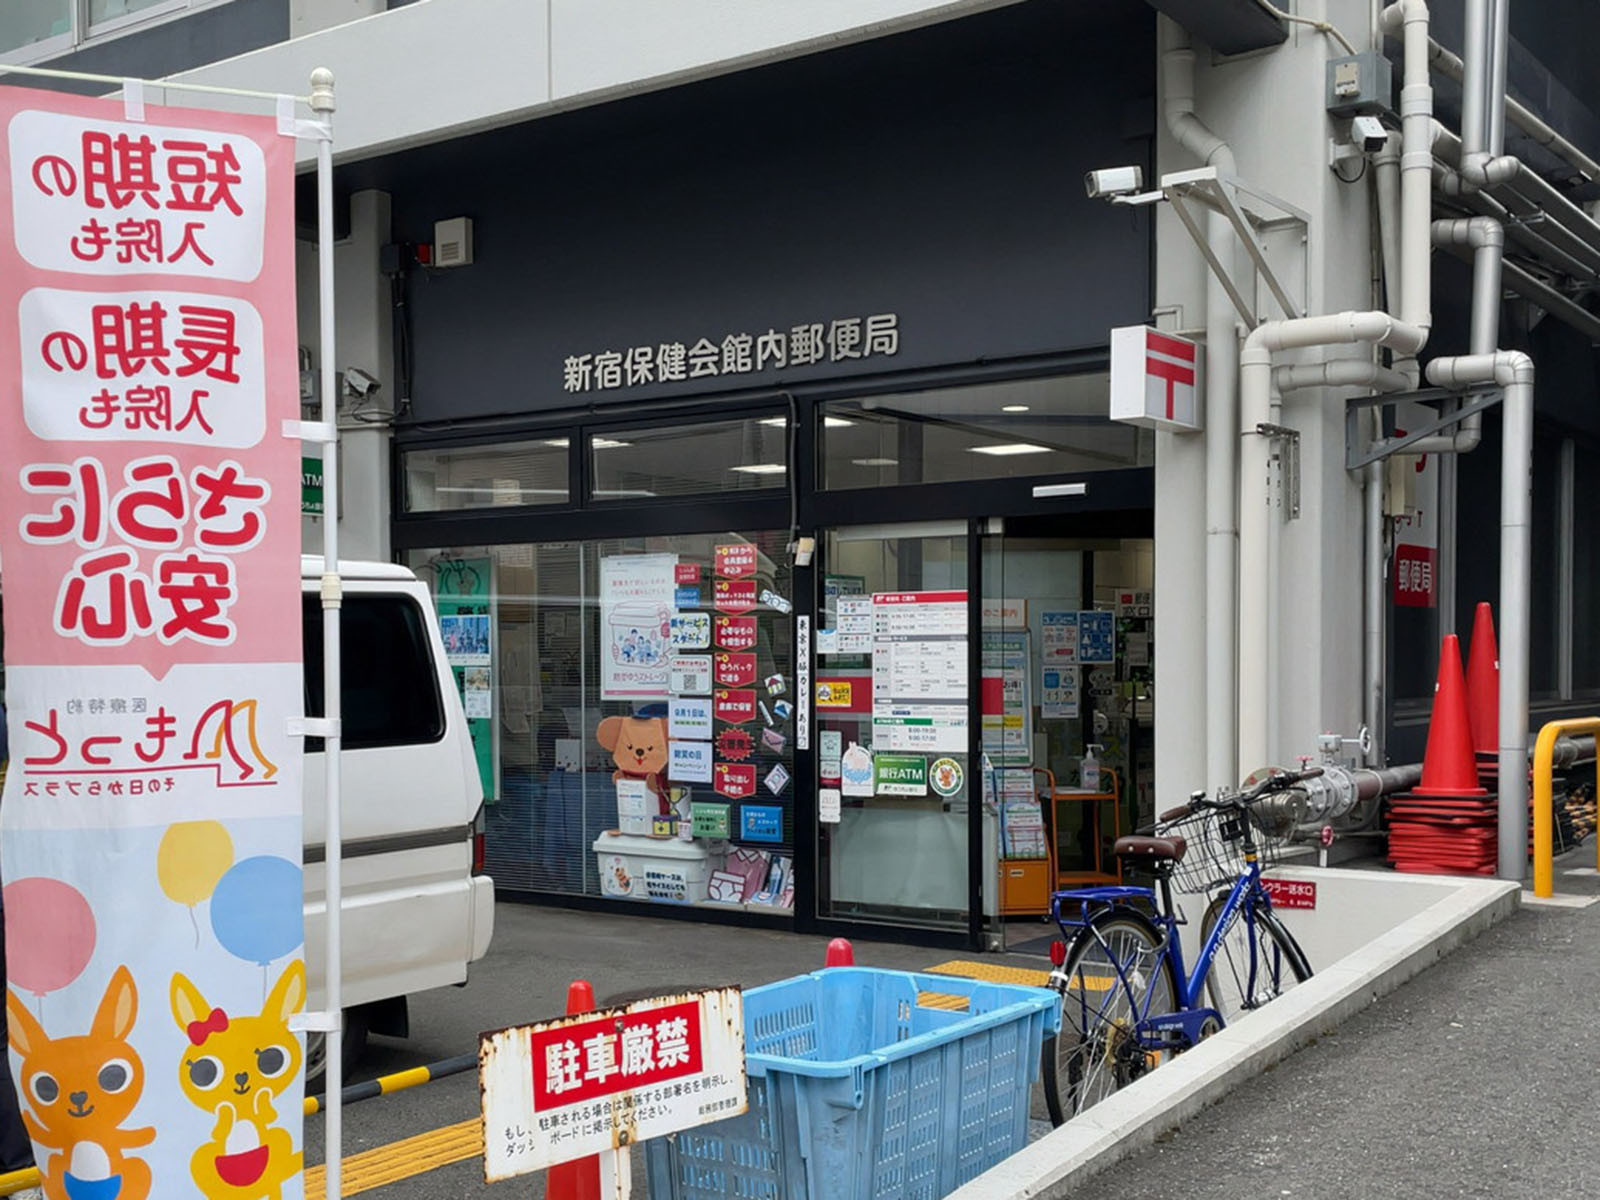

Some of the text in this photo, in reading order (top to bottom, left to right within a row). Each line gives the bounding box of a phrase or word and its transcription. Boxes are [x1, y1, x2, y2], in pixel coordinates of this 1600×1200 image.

[563, 313, 898, 393] 新宿保健会館内郵便局
[1398, 558, 1432, 593] 郵便局
[879, 767, 923, 780] 銀行ATM
[545, 1016, 690, 1094] 駐車厳禁
